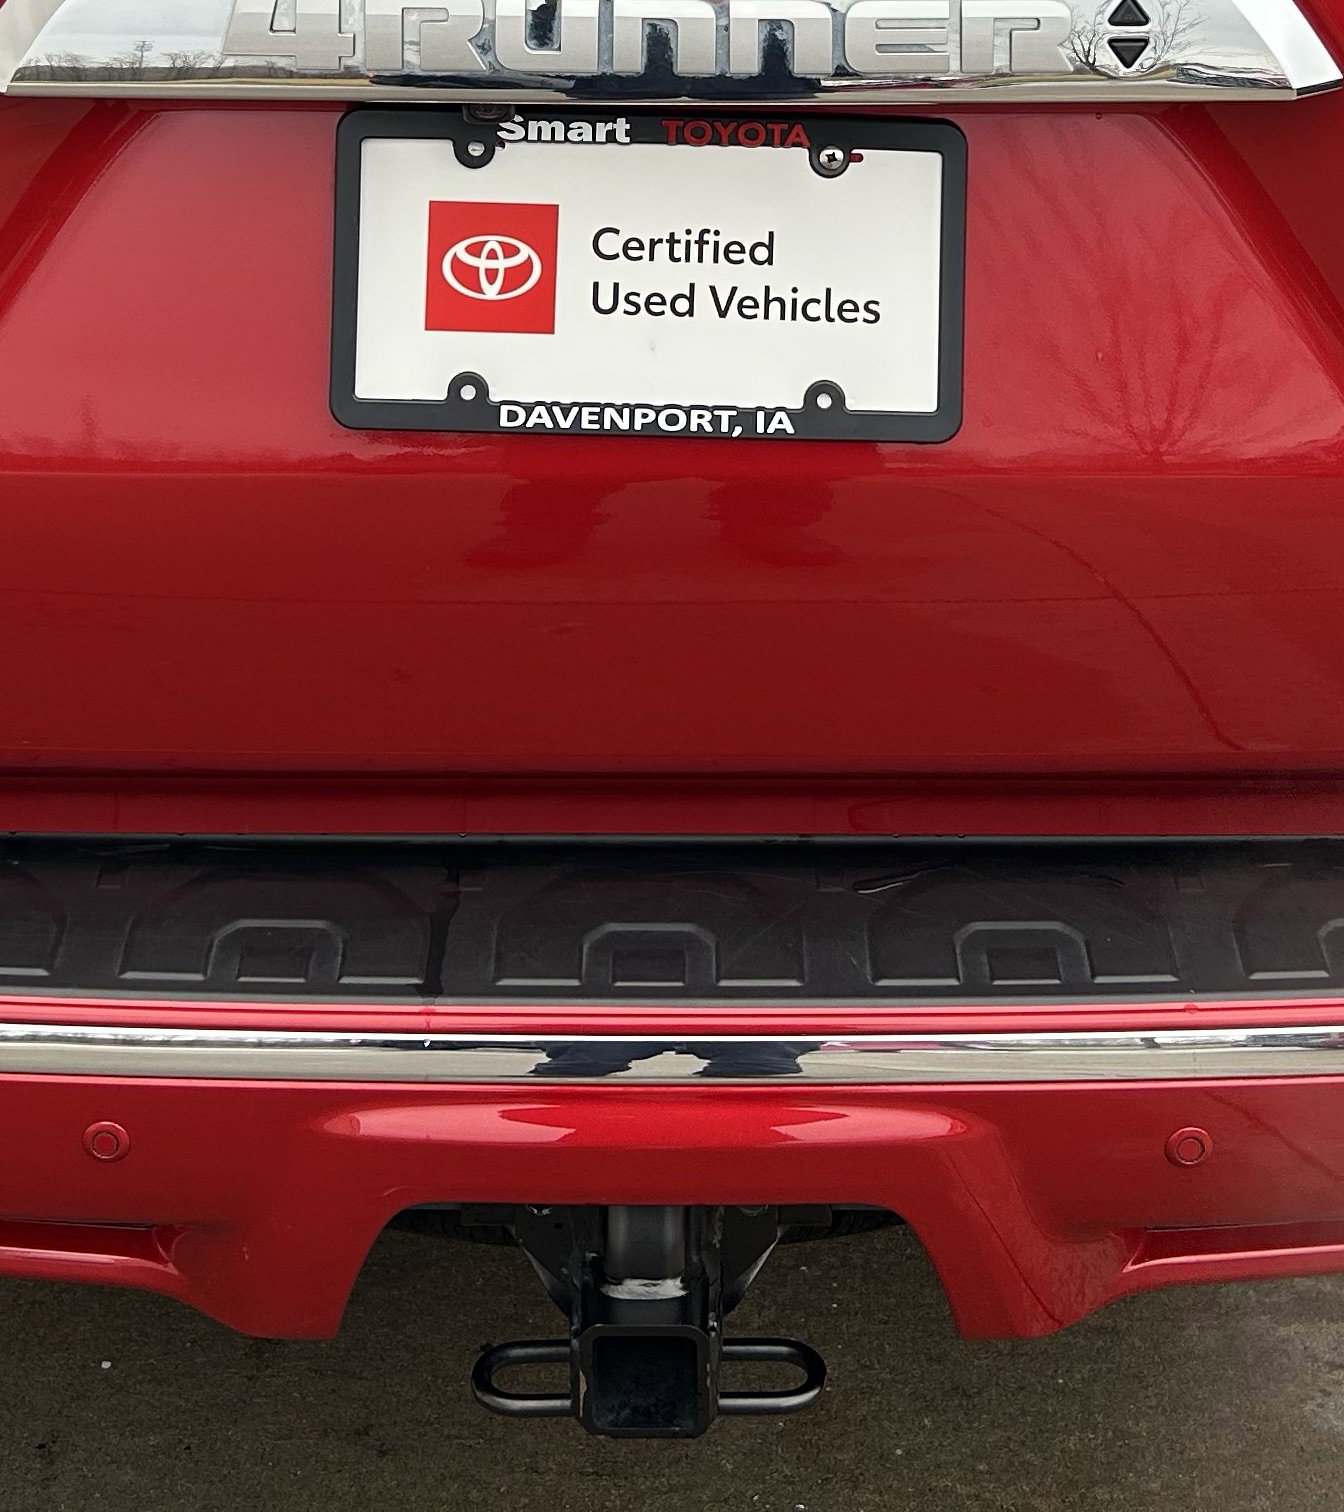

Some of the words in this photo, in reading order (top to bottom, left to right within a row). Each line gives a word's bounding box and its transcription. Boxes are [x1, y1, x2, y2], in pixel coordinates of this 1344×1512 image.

[496, 114, 631, 143] Smart
[662, 120, 811, 148] TOYOTA
[592, 226, 775, 267] Certified
[592, 280, 696, 318] Used
[709, 285, 881, 325] Vehicles
[499, 404, 744, 438] DAVENPORT,
[756, 410, 795, 435] IA
